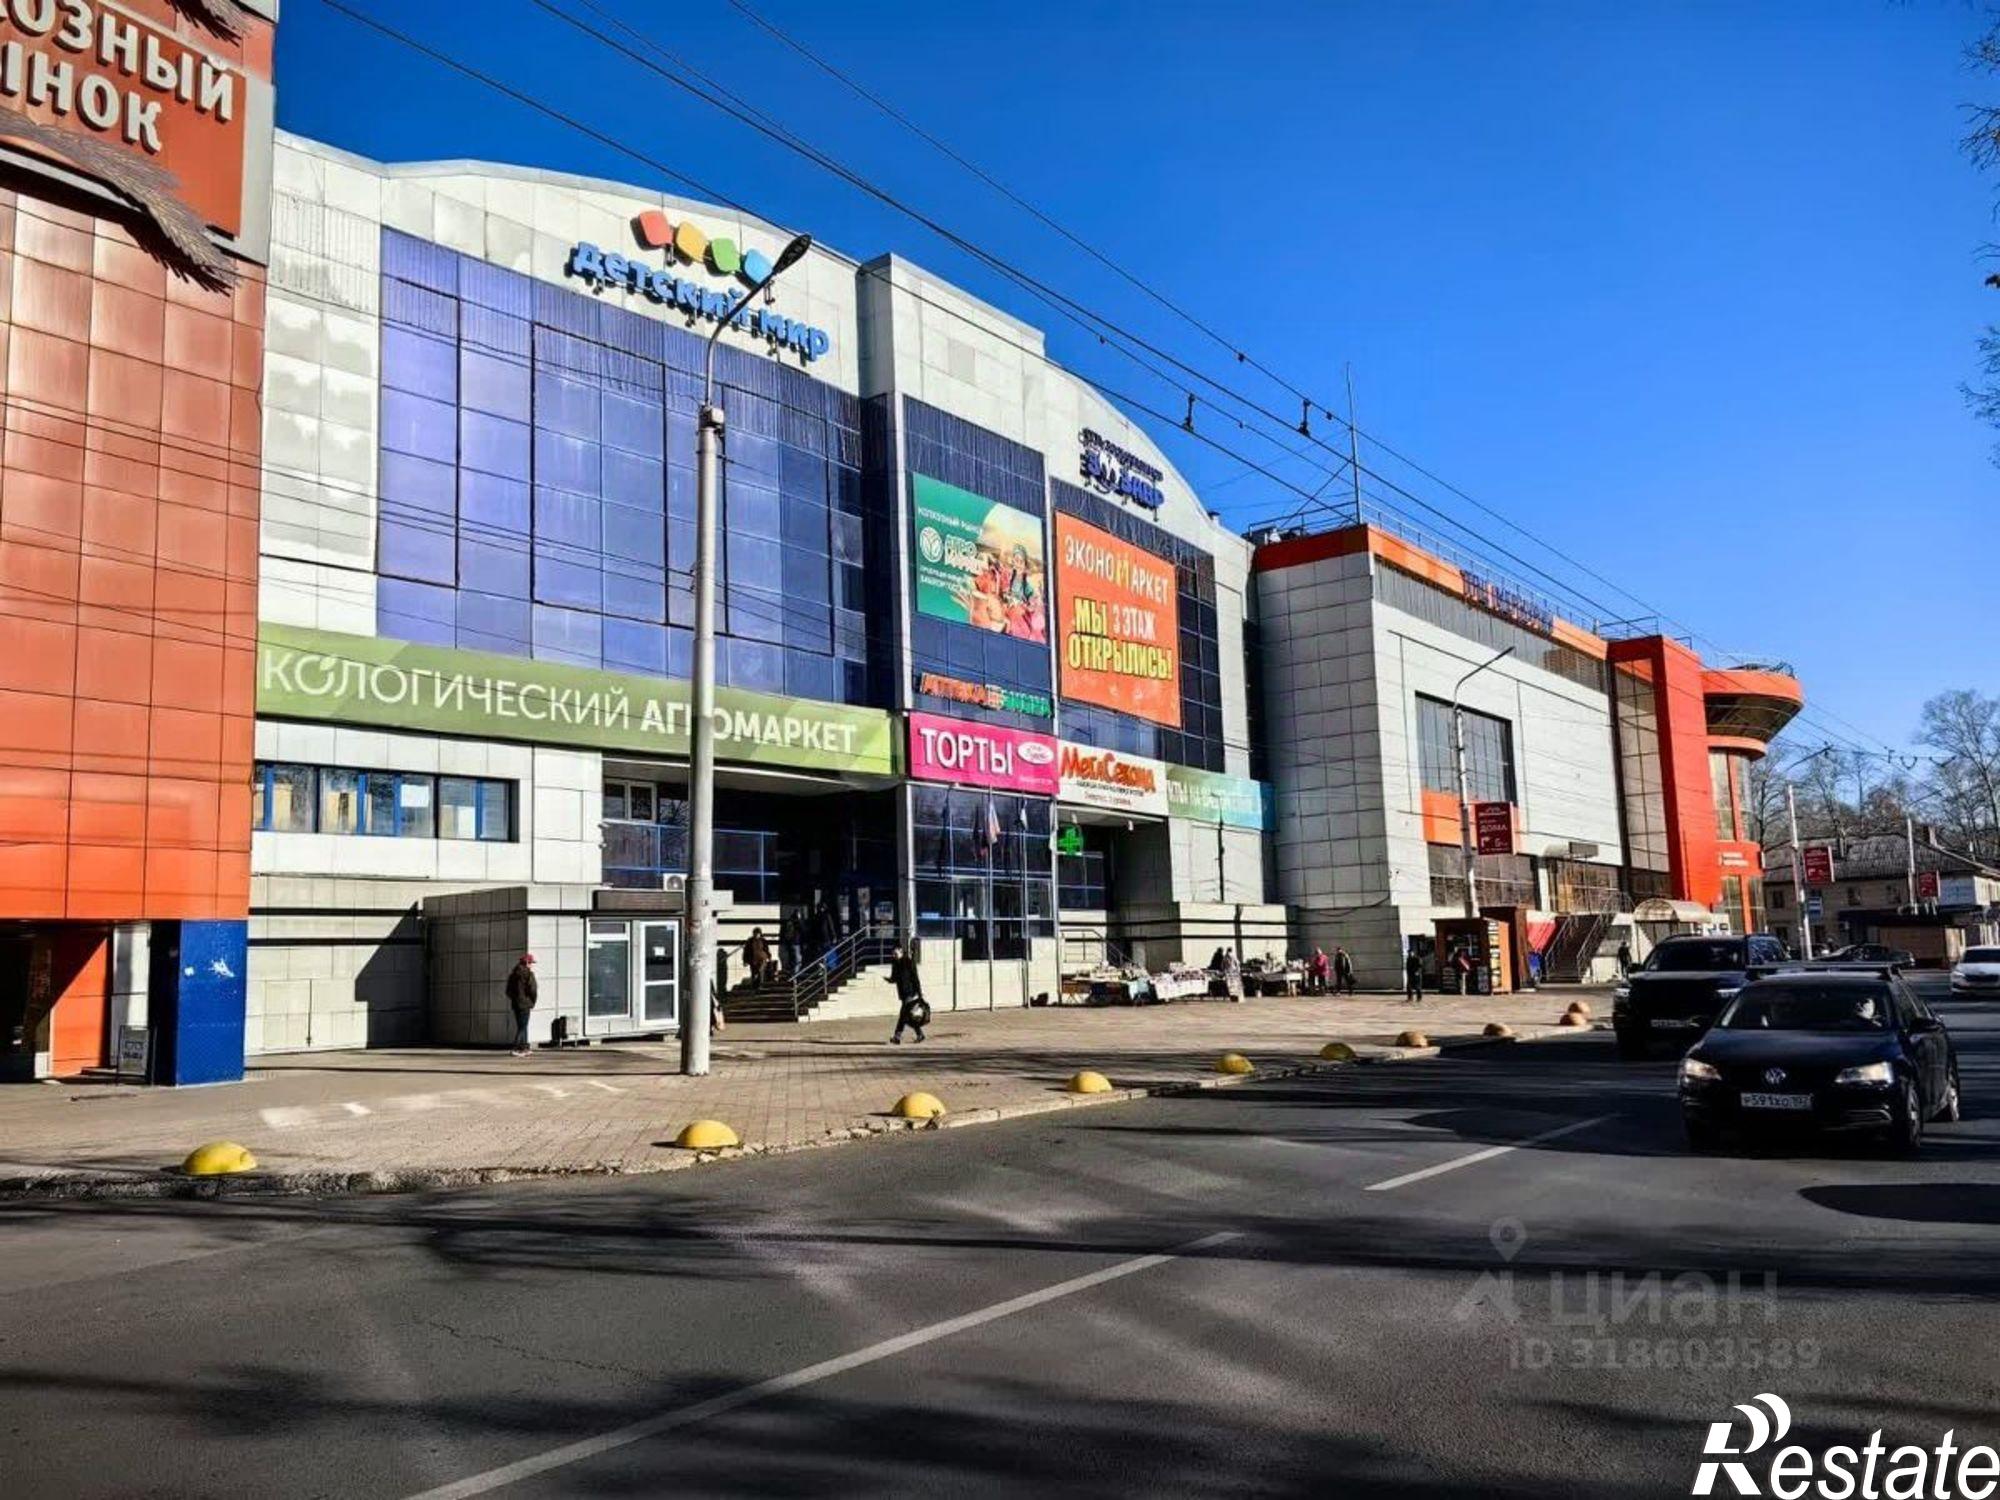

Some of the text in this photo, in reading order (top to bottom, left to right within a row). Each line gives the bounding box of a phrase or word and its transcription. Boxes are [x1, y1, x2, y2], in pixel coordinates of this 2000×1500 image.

[0, 0, 232, 120] ОЗНЫЙ
[1073, 596, 1108, 637] МЫ
[1111, 603, 1157, 641] 3 ЭТАЖ
[1067, 631, 1174, 681] ОТКРЫЛИСЬ!
[919, 727, 1013, 776] ТОРТЫ
